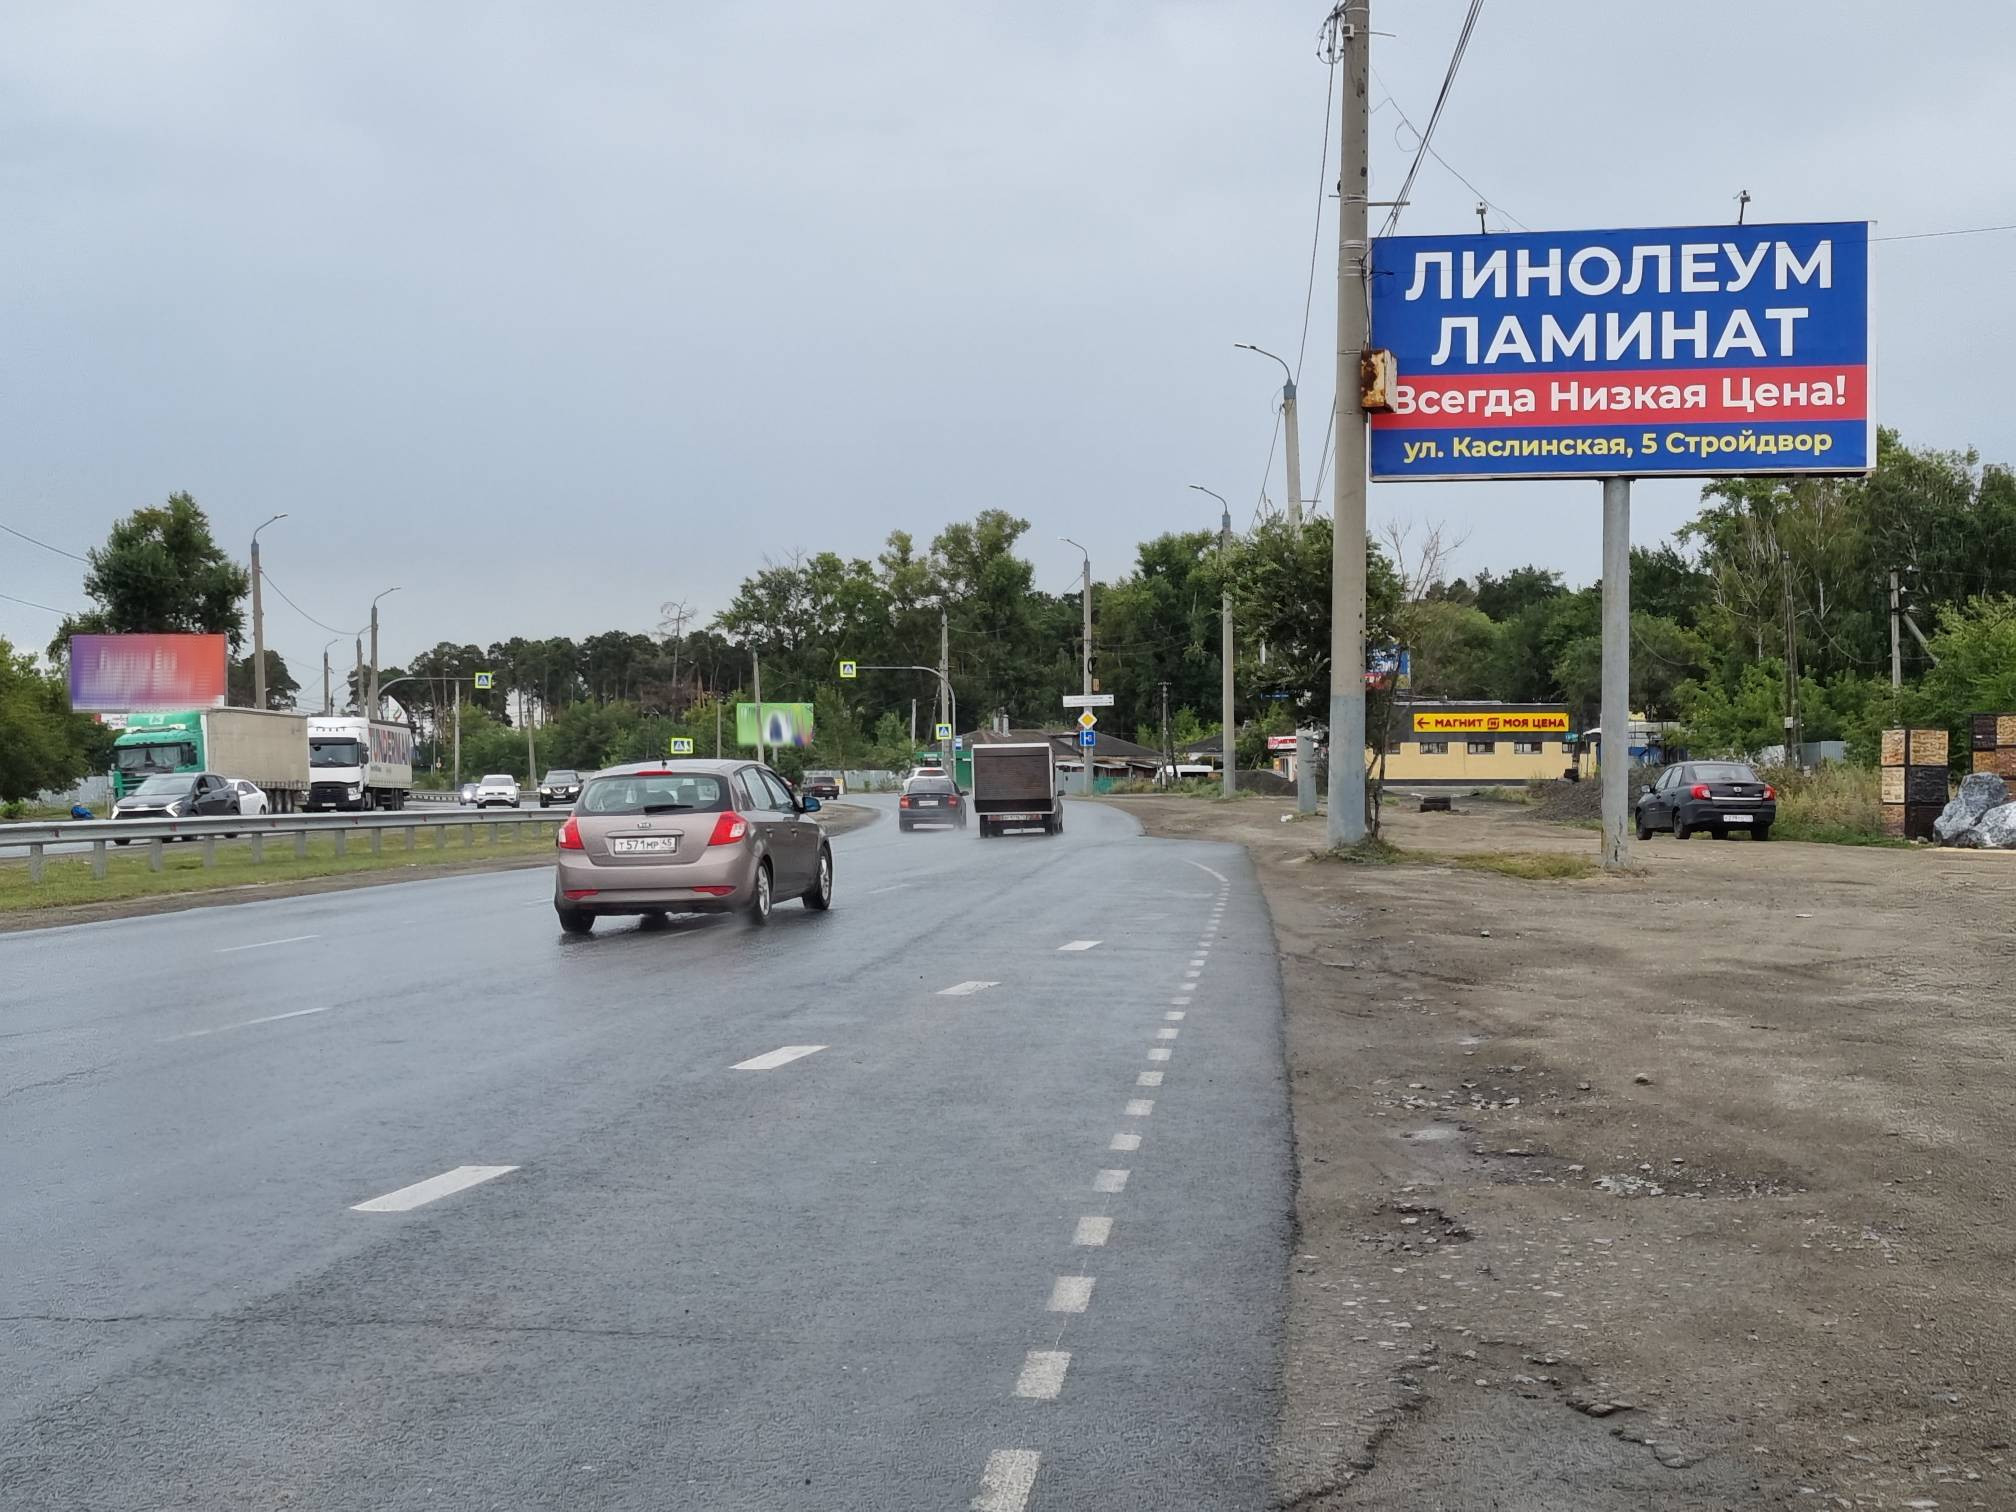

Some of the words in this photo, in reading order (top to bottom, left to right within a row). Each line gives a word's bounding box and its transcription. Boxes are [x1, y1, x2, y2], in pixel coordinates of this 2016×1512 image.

[1405, 239, 1832, 301] ЛИНОЛЕУМ
[1430, 307, 1809, 366] ЛАМИНАТ
[1395, 385, 1536, 417] Всегда
[1551, 381, 1706, 412] Низкая
[1722, 375, 1846, 413] Цена!
[1403, 441, 1444, 464] ул.
[1453, 436, 1633, 458] Каслинская,
[1641, 433, 1658, 454] 5
[1665, 429, 1833, 458] Стройдвор
[1434, 718, 1483, 728] МАГНИТ
[1503, 718, 1529, 728] МОЯ
[1532, 718, 1566, 730] ЦЕНА
